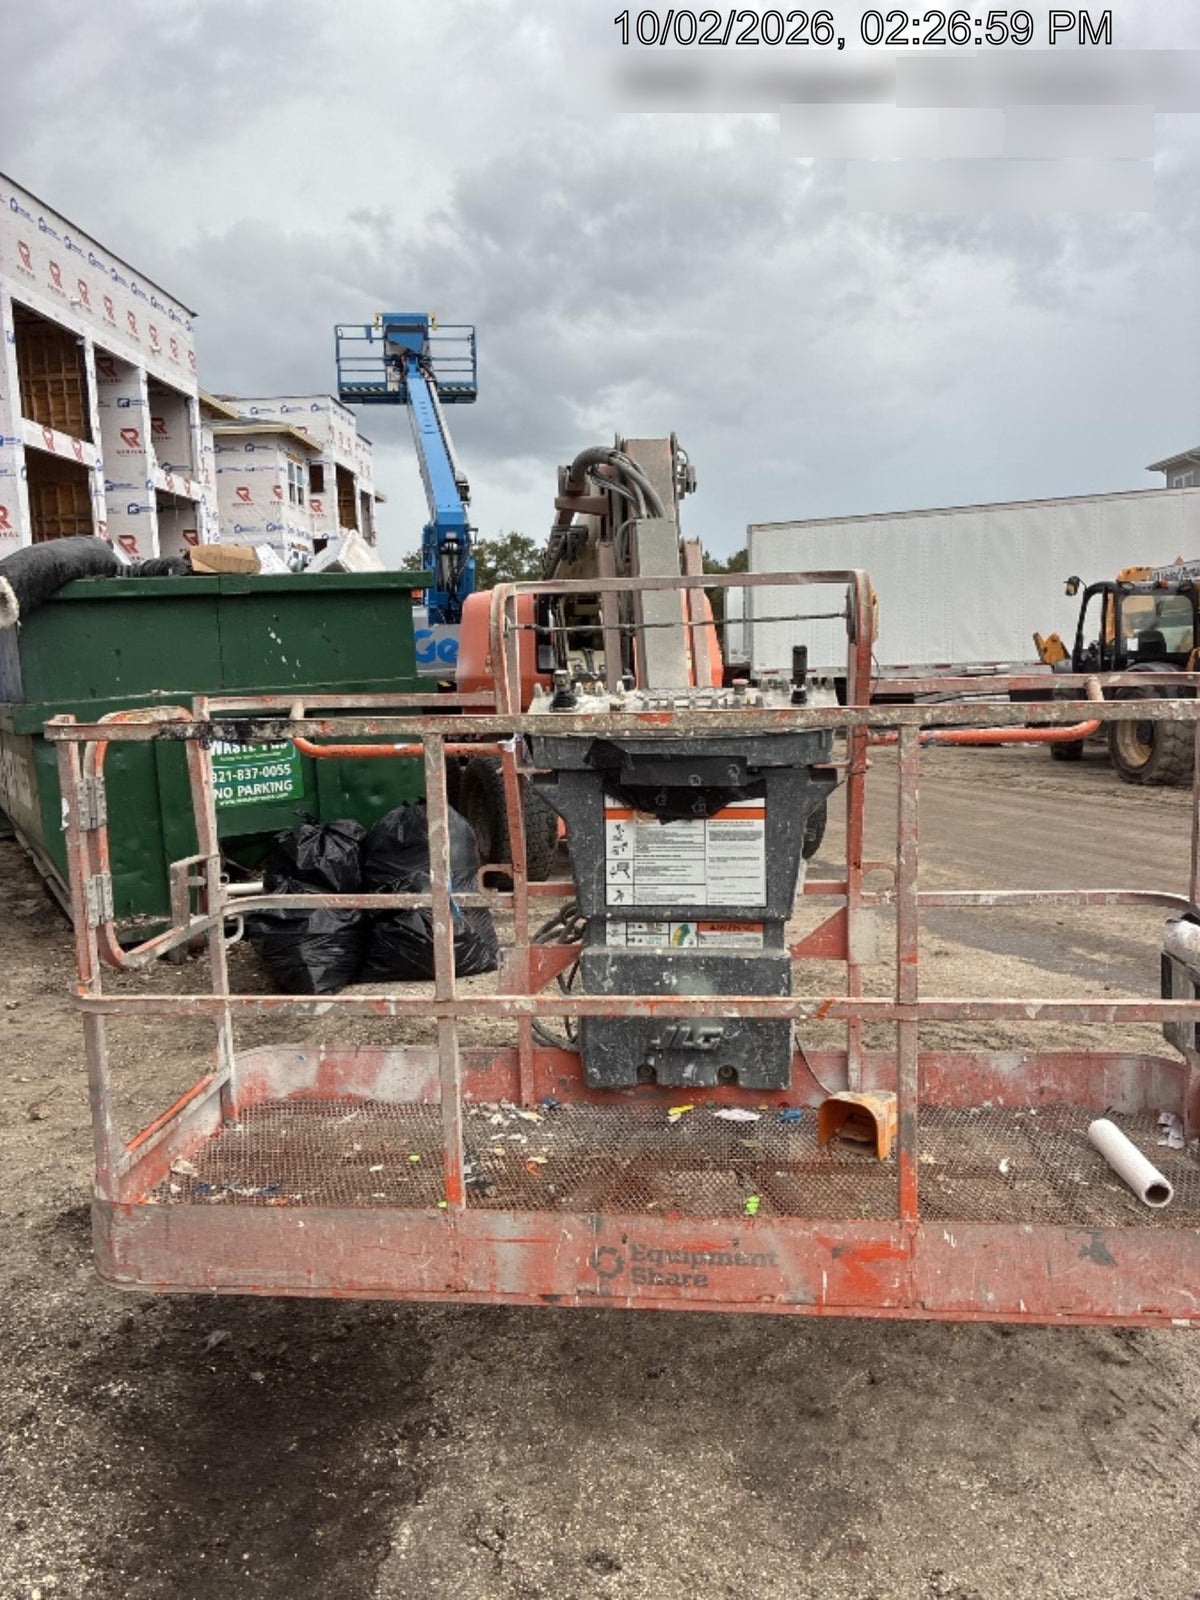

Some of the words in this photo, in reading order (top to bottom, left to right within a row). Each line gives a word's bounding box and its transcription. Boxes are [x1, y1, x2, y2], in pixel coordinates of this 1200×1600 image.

[214, 787, 234, 799] NO
[237, 780, 294, 797] PARKING
[629, 1243, 778, 1268] Equipment
[629, 1266, 709, 1288] Share
